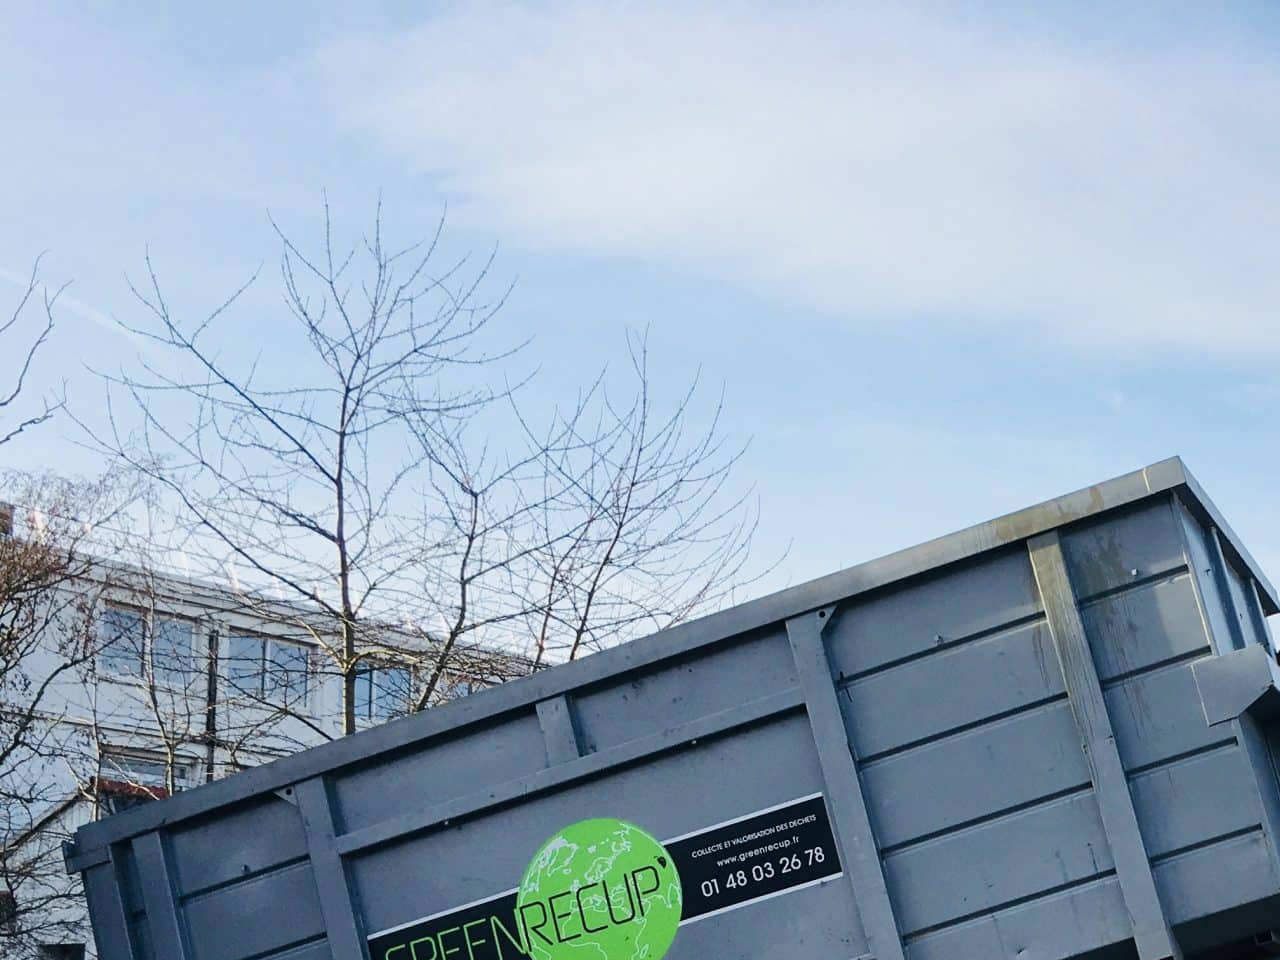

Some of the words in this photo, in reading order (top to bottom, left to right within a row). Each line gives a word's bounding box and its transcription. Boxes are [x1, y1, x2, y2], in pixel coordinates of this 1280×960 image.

[691, 844, 723, 858] COLLECTE
[724, 841, 732, 849] ET
[732, 825, 776, 845] VALORISATION
[776, 822, 789, 832] DES
[717, 836, 800, 867] www.greenrecup.fr
[701, 878, 720, 897] 01
[725, 870, 747, 889] 48
[752, 862, 775, 881] 03
[779, 854, 801, 873] 26
[804, 846, 825, 866] 78
